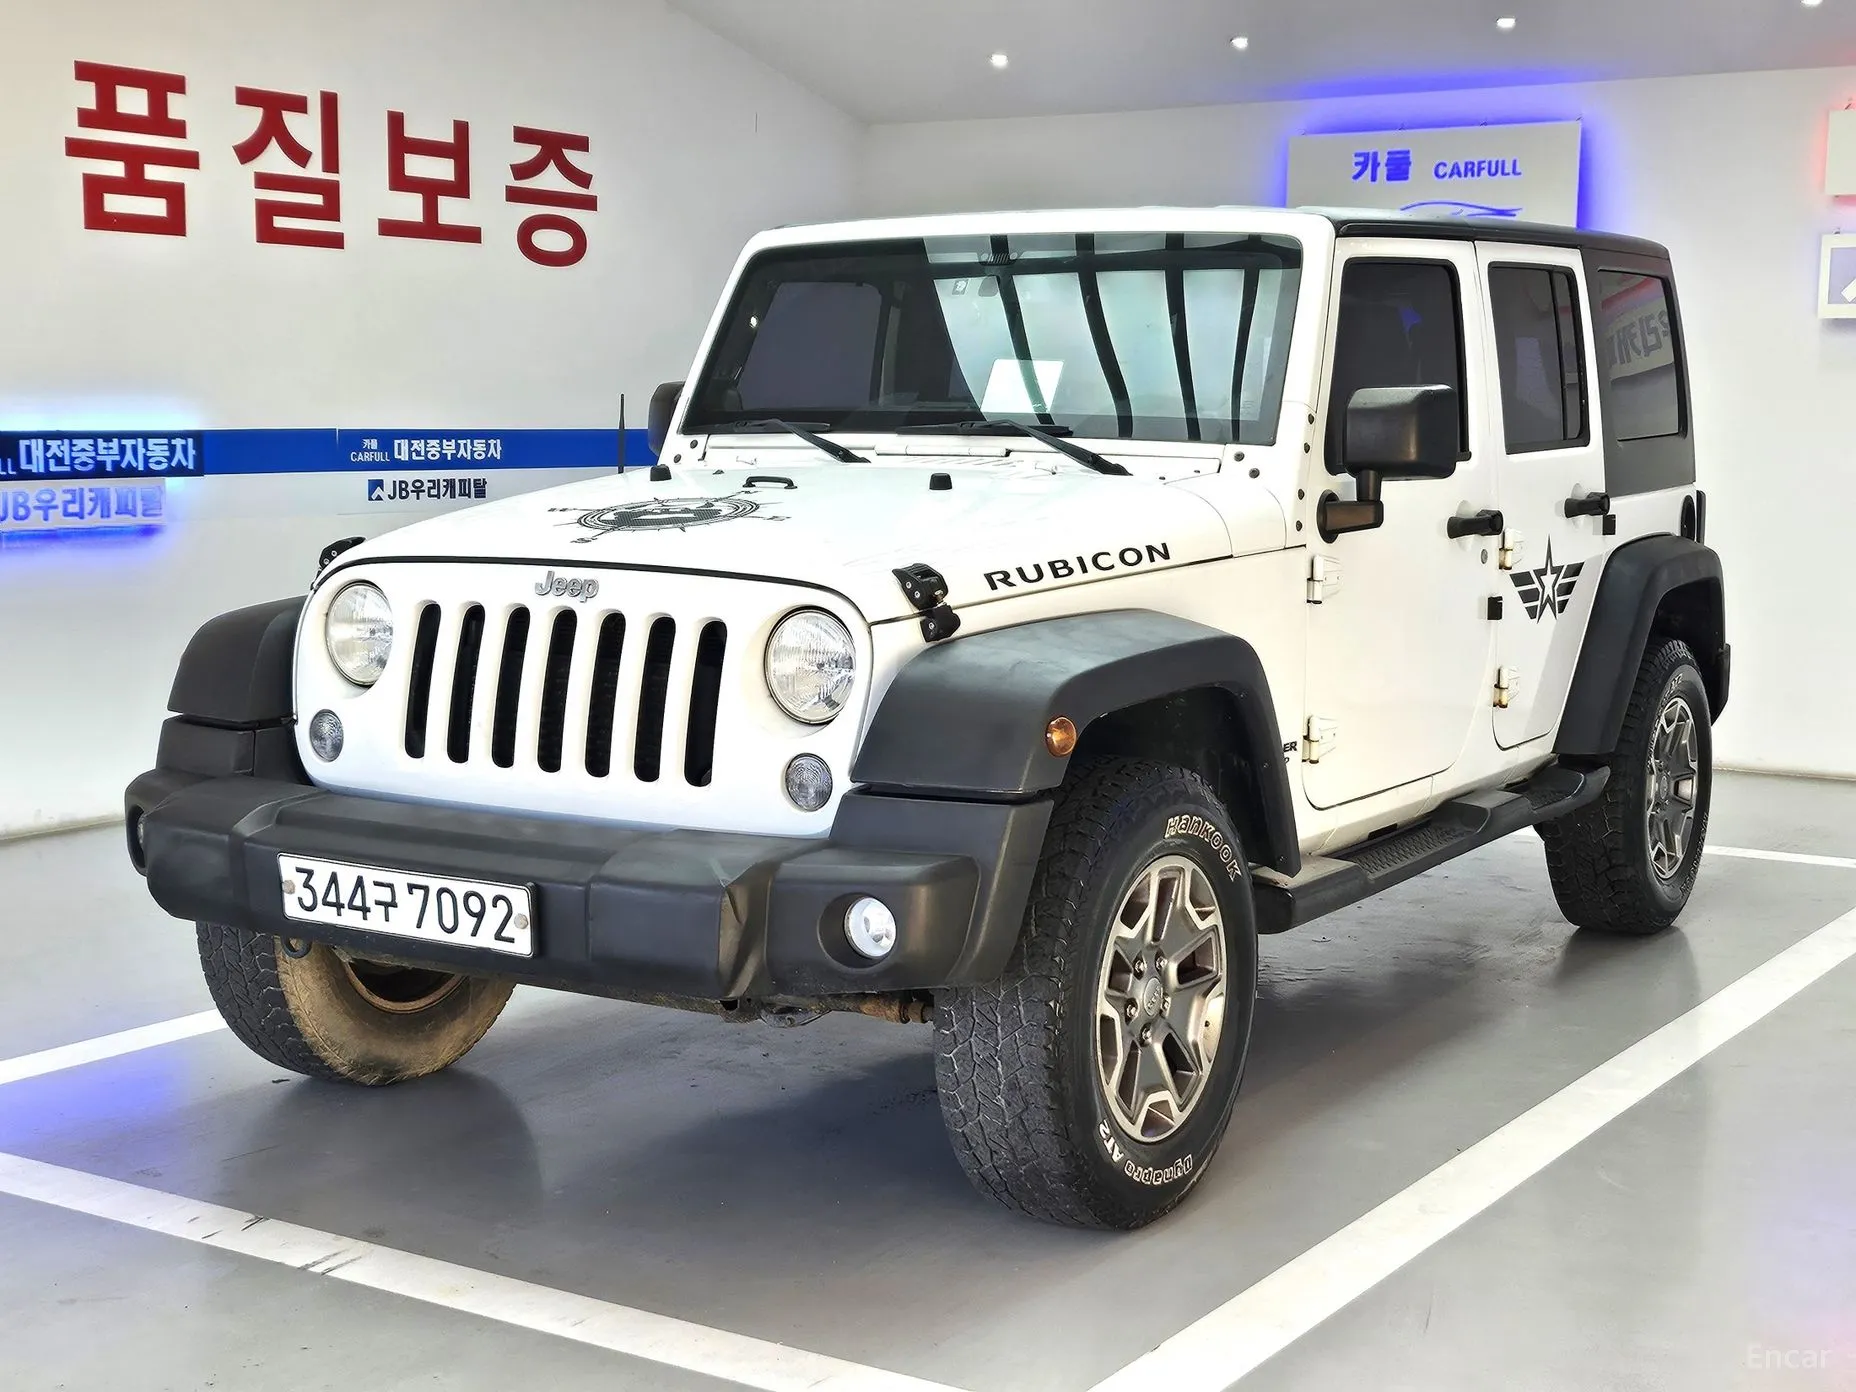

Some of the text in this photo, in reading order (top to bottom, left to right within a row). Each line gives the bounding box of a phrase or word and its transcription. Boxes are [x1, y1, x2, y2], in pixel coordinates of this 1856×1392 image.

[64, 59, 599, 268] 품질보증
[1434, 159, 1522, 180] CARFULL
[18, 437, 196, 474] 대전중부자동차
[350, 439, 502, 462] CARFULL 대전중부자동차
[387, 477, 488, 500] JB우리캐피탈
[983, 542, 1171, 591] RUBICON
[535, 570, 600, 603] Jeep
[406, 882, 515, 944] 7092
